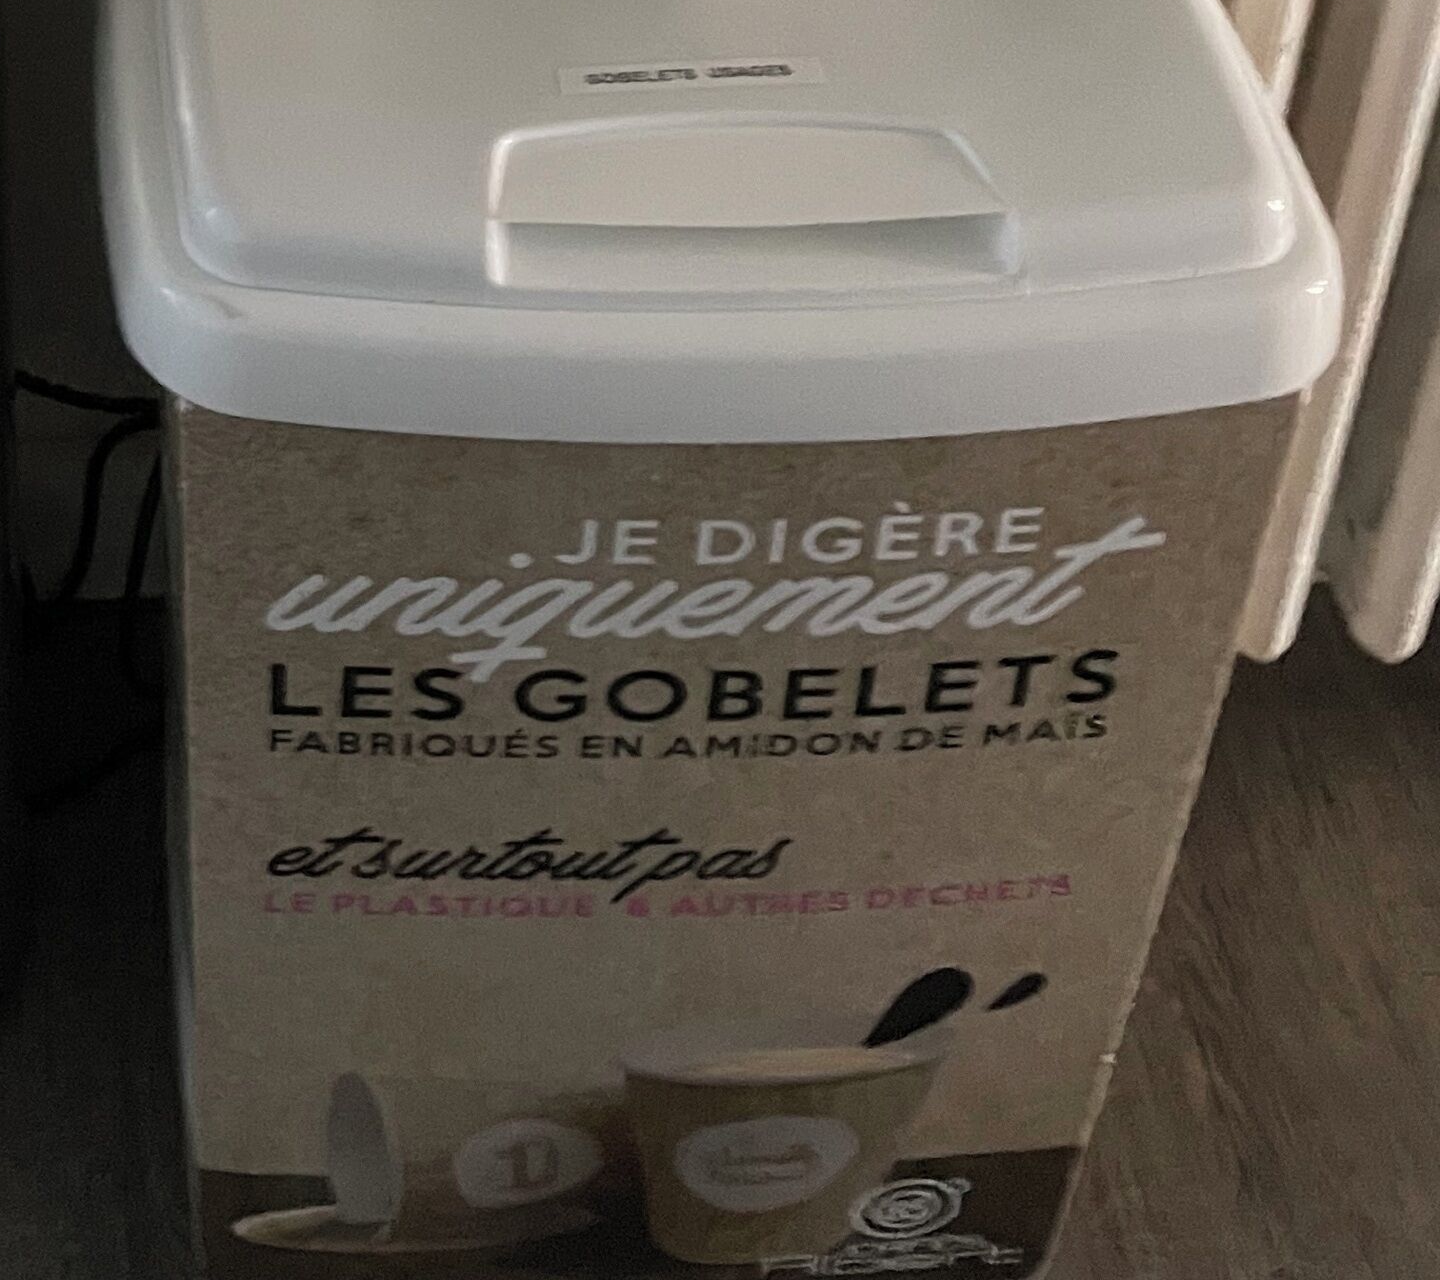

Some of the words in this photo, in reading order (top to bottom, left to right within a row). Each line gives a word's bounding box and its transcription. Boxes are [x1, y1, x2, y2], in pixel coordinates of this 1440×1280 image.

[555, 519, 658, 567] JE
[697, 502, 1045, 566] DIGÈRE
[265, 514, 1166, 683] uniquement
[269, 663, 464, 719] LES
[515, 649, 1120, 723] GOBELETS
[269, 727, 561, 760] FABRIQUÉS
[581, 733, 643, 759] EN
[666, 727, 882, 760] AMIDON
[898, 725, 967, 753] DE
[983, 713, 1109, 745] MAÏS
[264, 891, 320, 916] LE
[332, 892, 595, 919] PLASTIQUE
[669, 889, 849, 918] AUTRES
